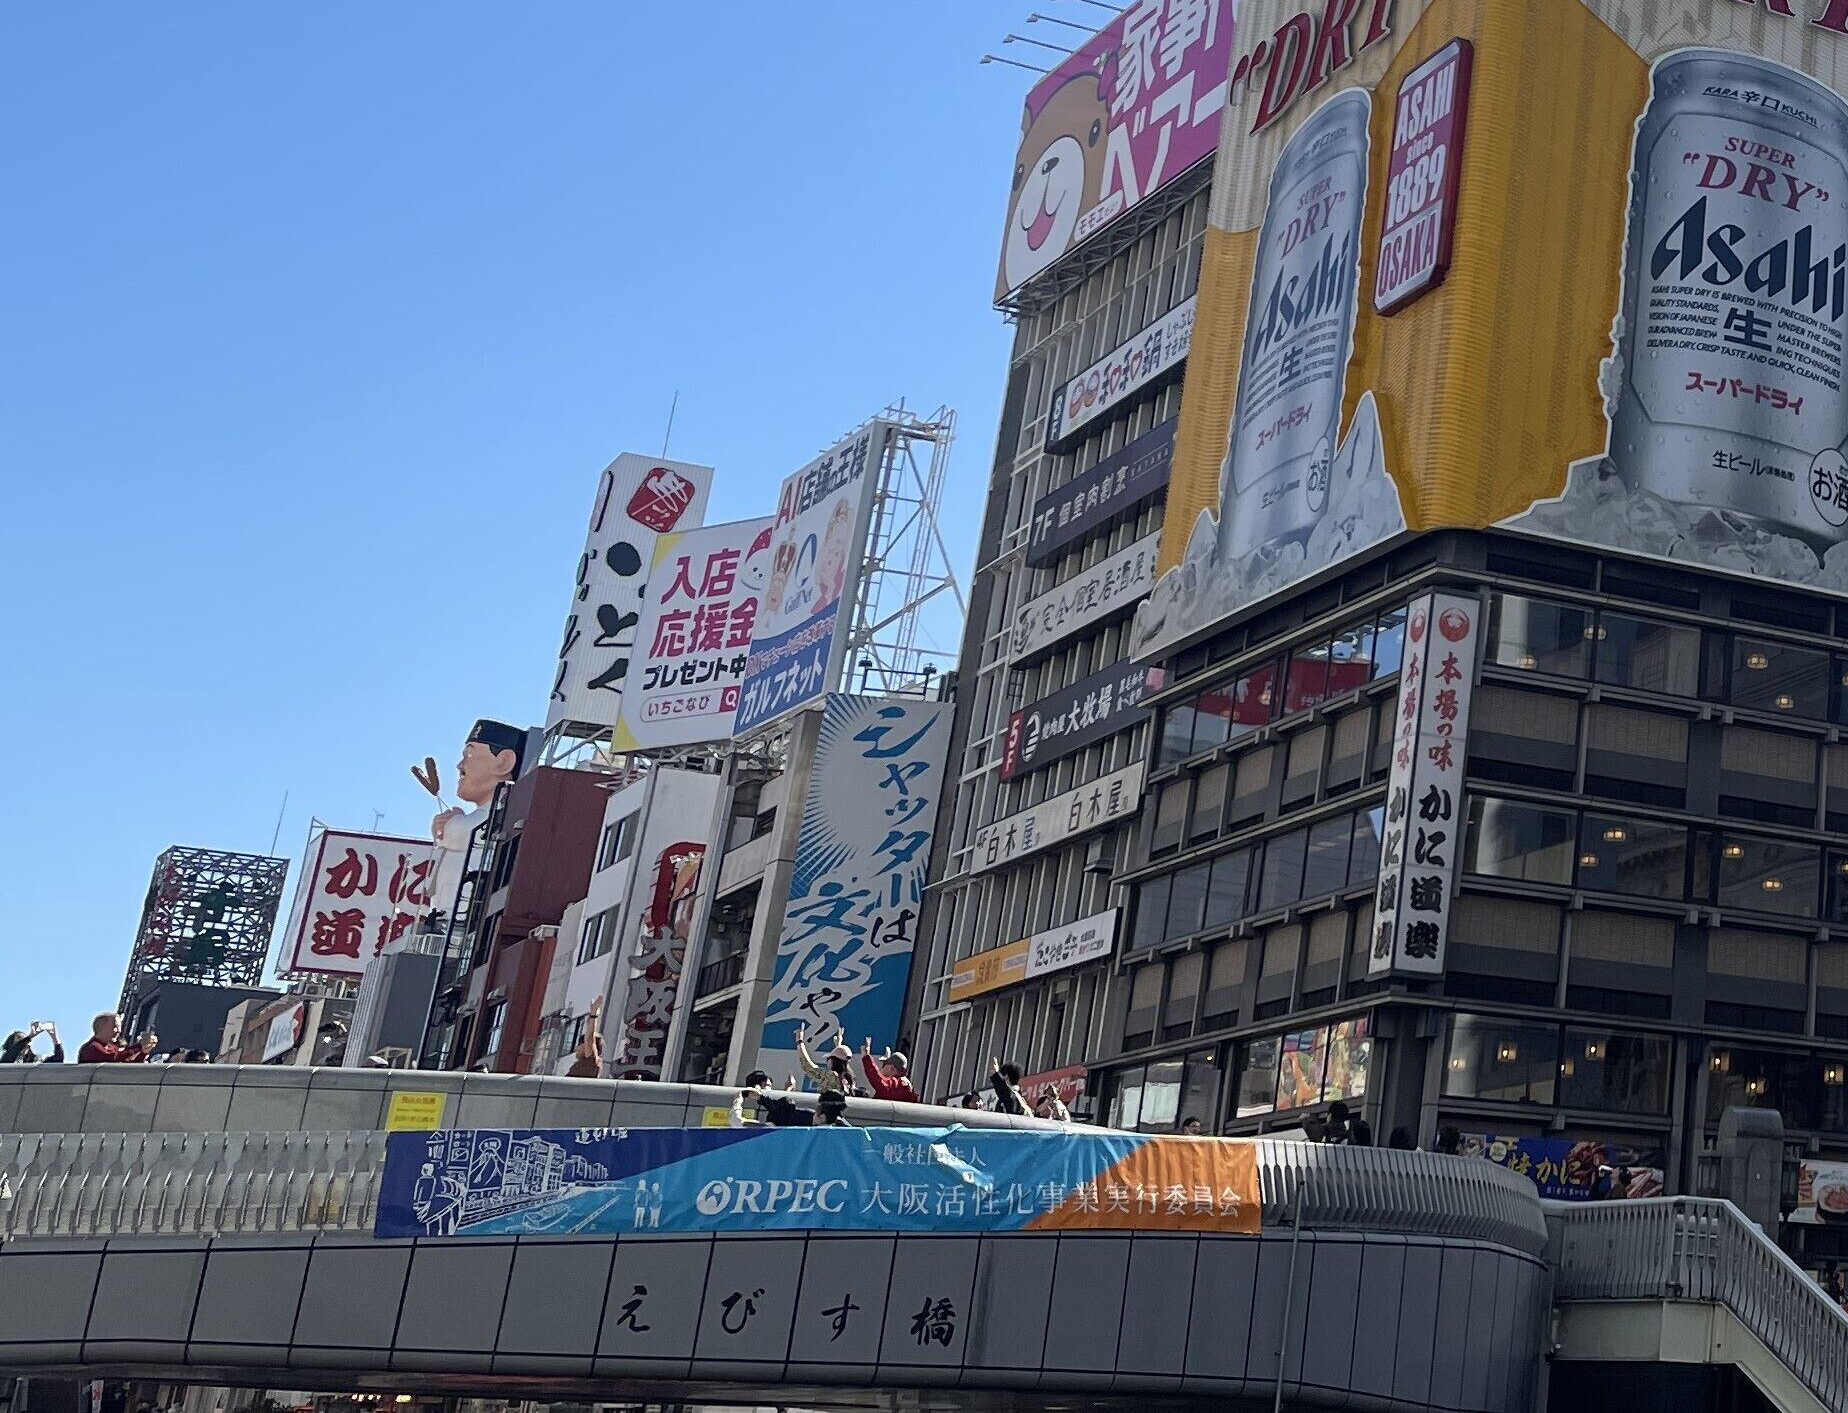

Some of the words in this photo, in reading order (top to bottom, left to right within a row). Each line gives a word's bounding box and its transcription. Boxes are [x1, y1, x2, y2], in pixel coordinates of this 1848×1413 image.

[1394, 60, 1455, 151] ASAHI
[1703, 86, 1739, 98] KARA
[1741, 90, 1780, 112] 辛口
[1781, 104, 1818, 127] KUCHI
[1406, 131, 1434, 164] since
[1725, 137, 1796, 169] SUPER
[1297, 176, 1332, 211] SUPER
[1386, 143, 1447, 230] 1889
[1378, 212, 1437, 298] OSAKA
[1650, 195, 1847, 323] Asahi
[1252, 227, 1349, 366] Asahi
[1694, 288, 1711, 298] DRY
[1757, 299, 1779, 313] WITH
[1721, 347, 1746, 360] TASTE
[1747, 352, 1767, 364] AND
[1723, 307, 1773, 352] 生
[1278, 346, 1303, 387] 生
[1685, 371, 1804, 415] スーパードライ
[1032, 507, 1055, 547] 7F
[661, 548, 741, 605] 入店
[1042, 551, 1145, 632] 完全個室居酒屋
[649, 596, 758, 659] 応援金
[643, 654, 747, 690] プレゼント中
[739, 648, 822, 727] ガルフネット
[648, 693, 710, 717] いちごなび
[1064, 684, 1113, 736] 大牧場
[1428, 651, 1463, 772] 本場の味
[1005, 718, 1020, 773] 5F
[853, 706, 943, 949] シャッターは
[1067, 779, 1123, 833] 白木屋
[986, 816, 1035, 866] 白木屋
[325, 847, 436, 906] かに
[860, 1180, 1242, 1217] 大阪活性化事業実行委員会
[616, 1284, 957, 1348] えびす橋
